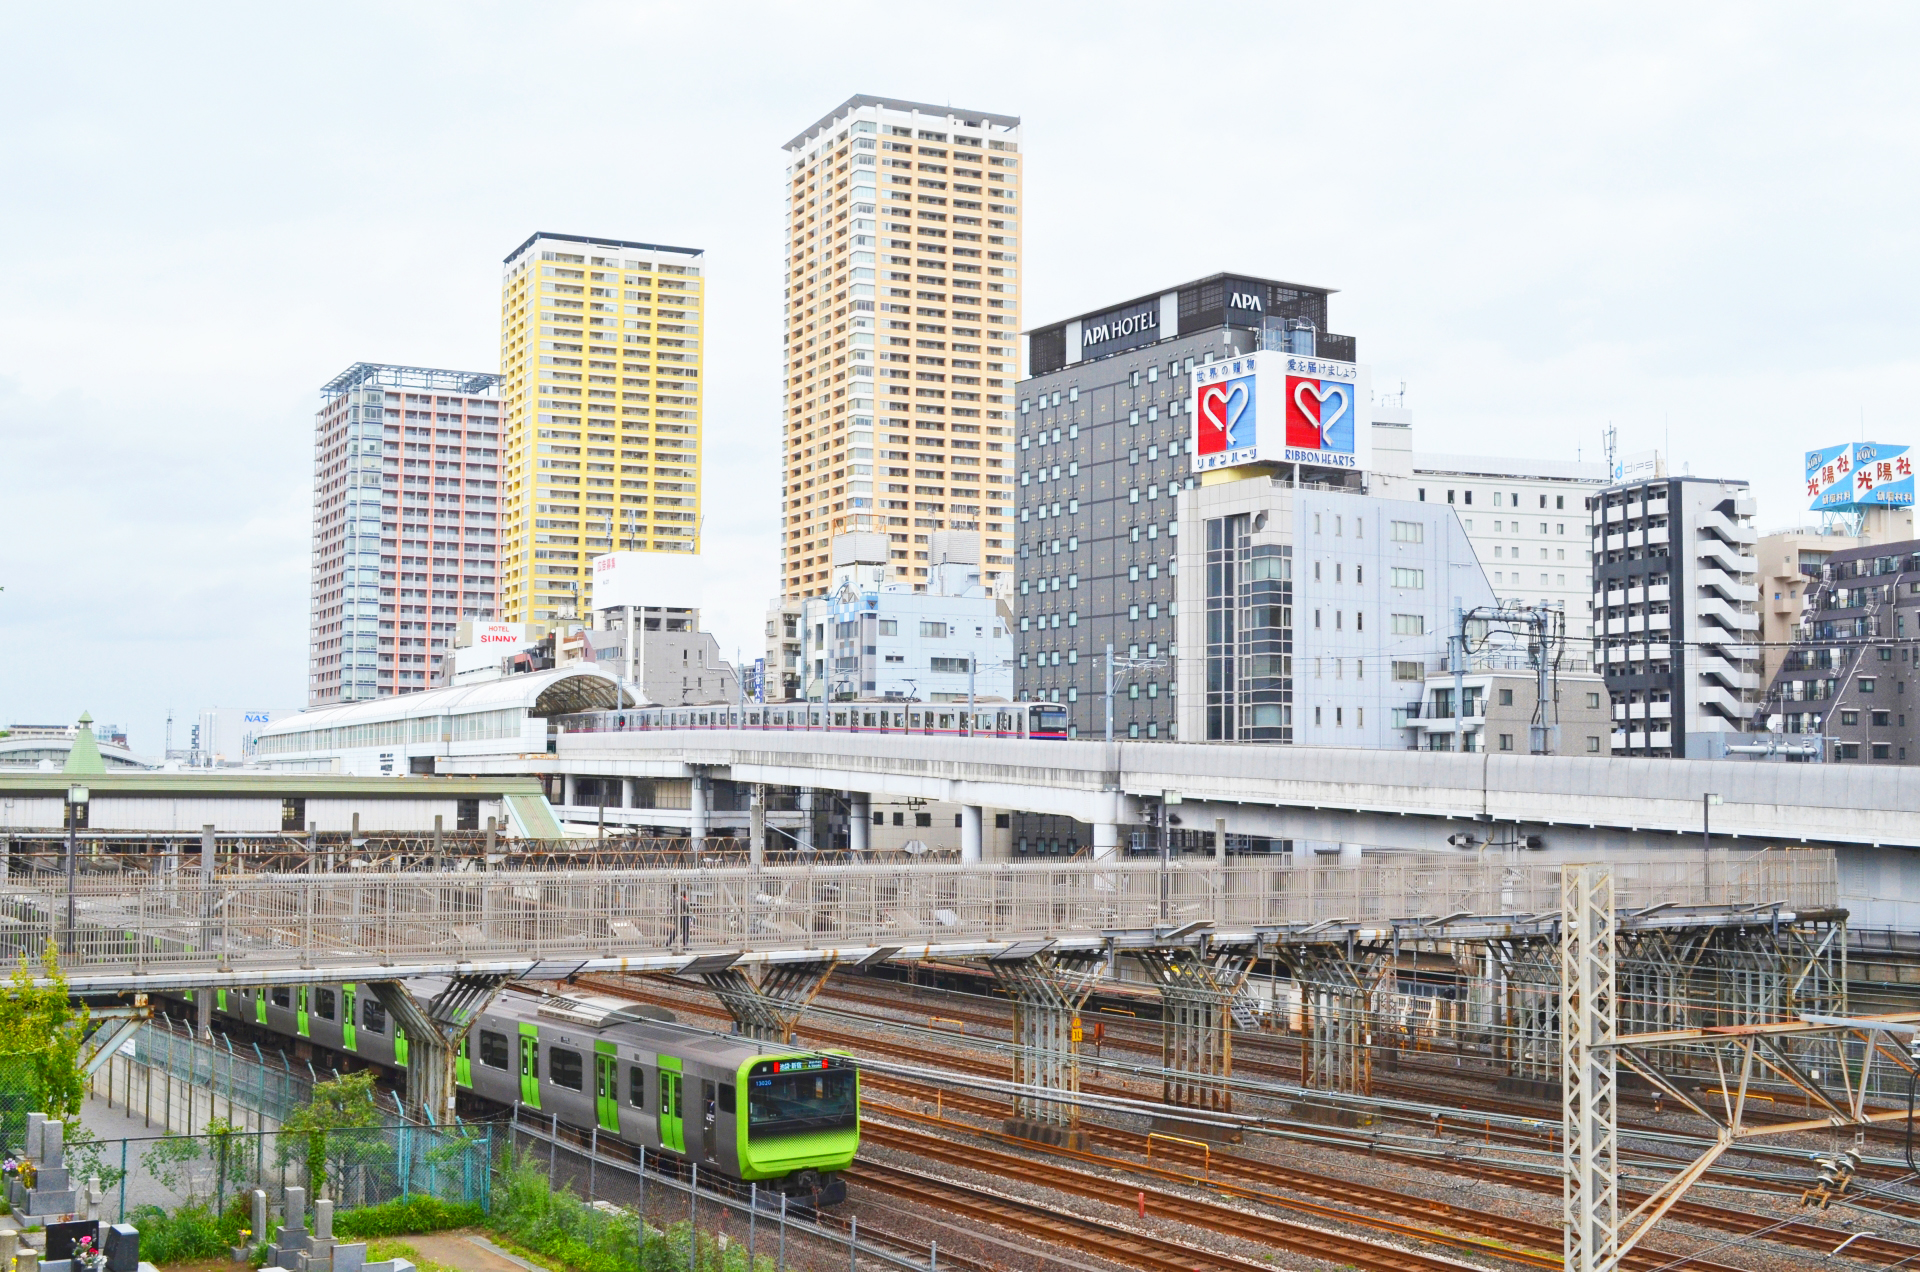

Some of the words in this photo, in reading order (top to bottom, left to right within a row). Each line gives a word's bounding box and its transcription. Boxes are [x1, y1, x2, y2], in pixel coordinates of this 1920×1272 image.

[1231, 292, 1262, 312] APA
[1084, 323, 1110, 347] APA
[1112, 311, 1157, 338] HOTEL
[1197, 359, 1256, 383] 世界の贈物
[1287, 358, 1357, 379] 愛を届けましょう
[1197, 449, 1257, 469] リボンハーツ
[1285, 449, 1320, 465] RIBBON
[1321, 453, 1356, 467] HEARTS
[1808, 455, 1850, 496] 光陽社
[1857, 457, 1912, 490] 光陽社
[480, 634, 518, 642] SUNNY
